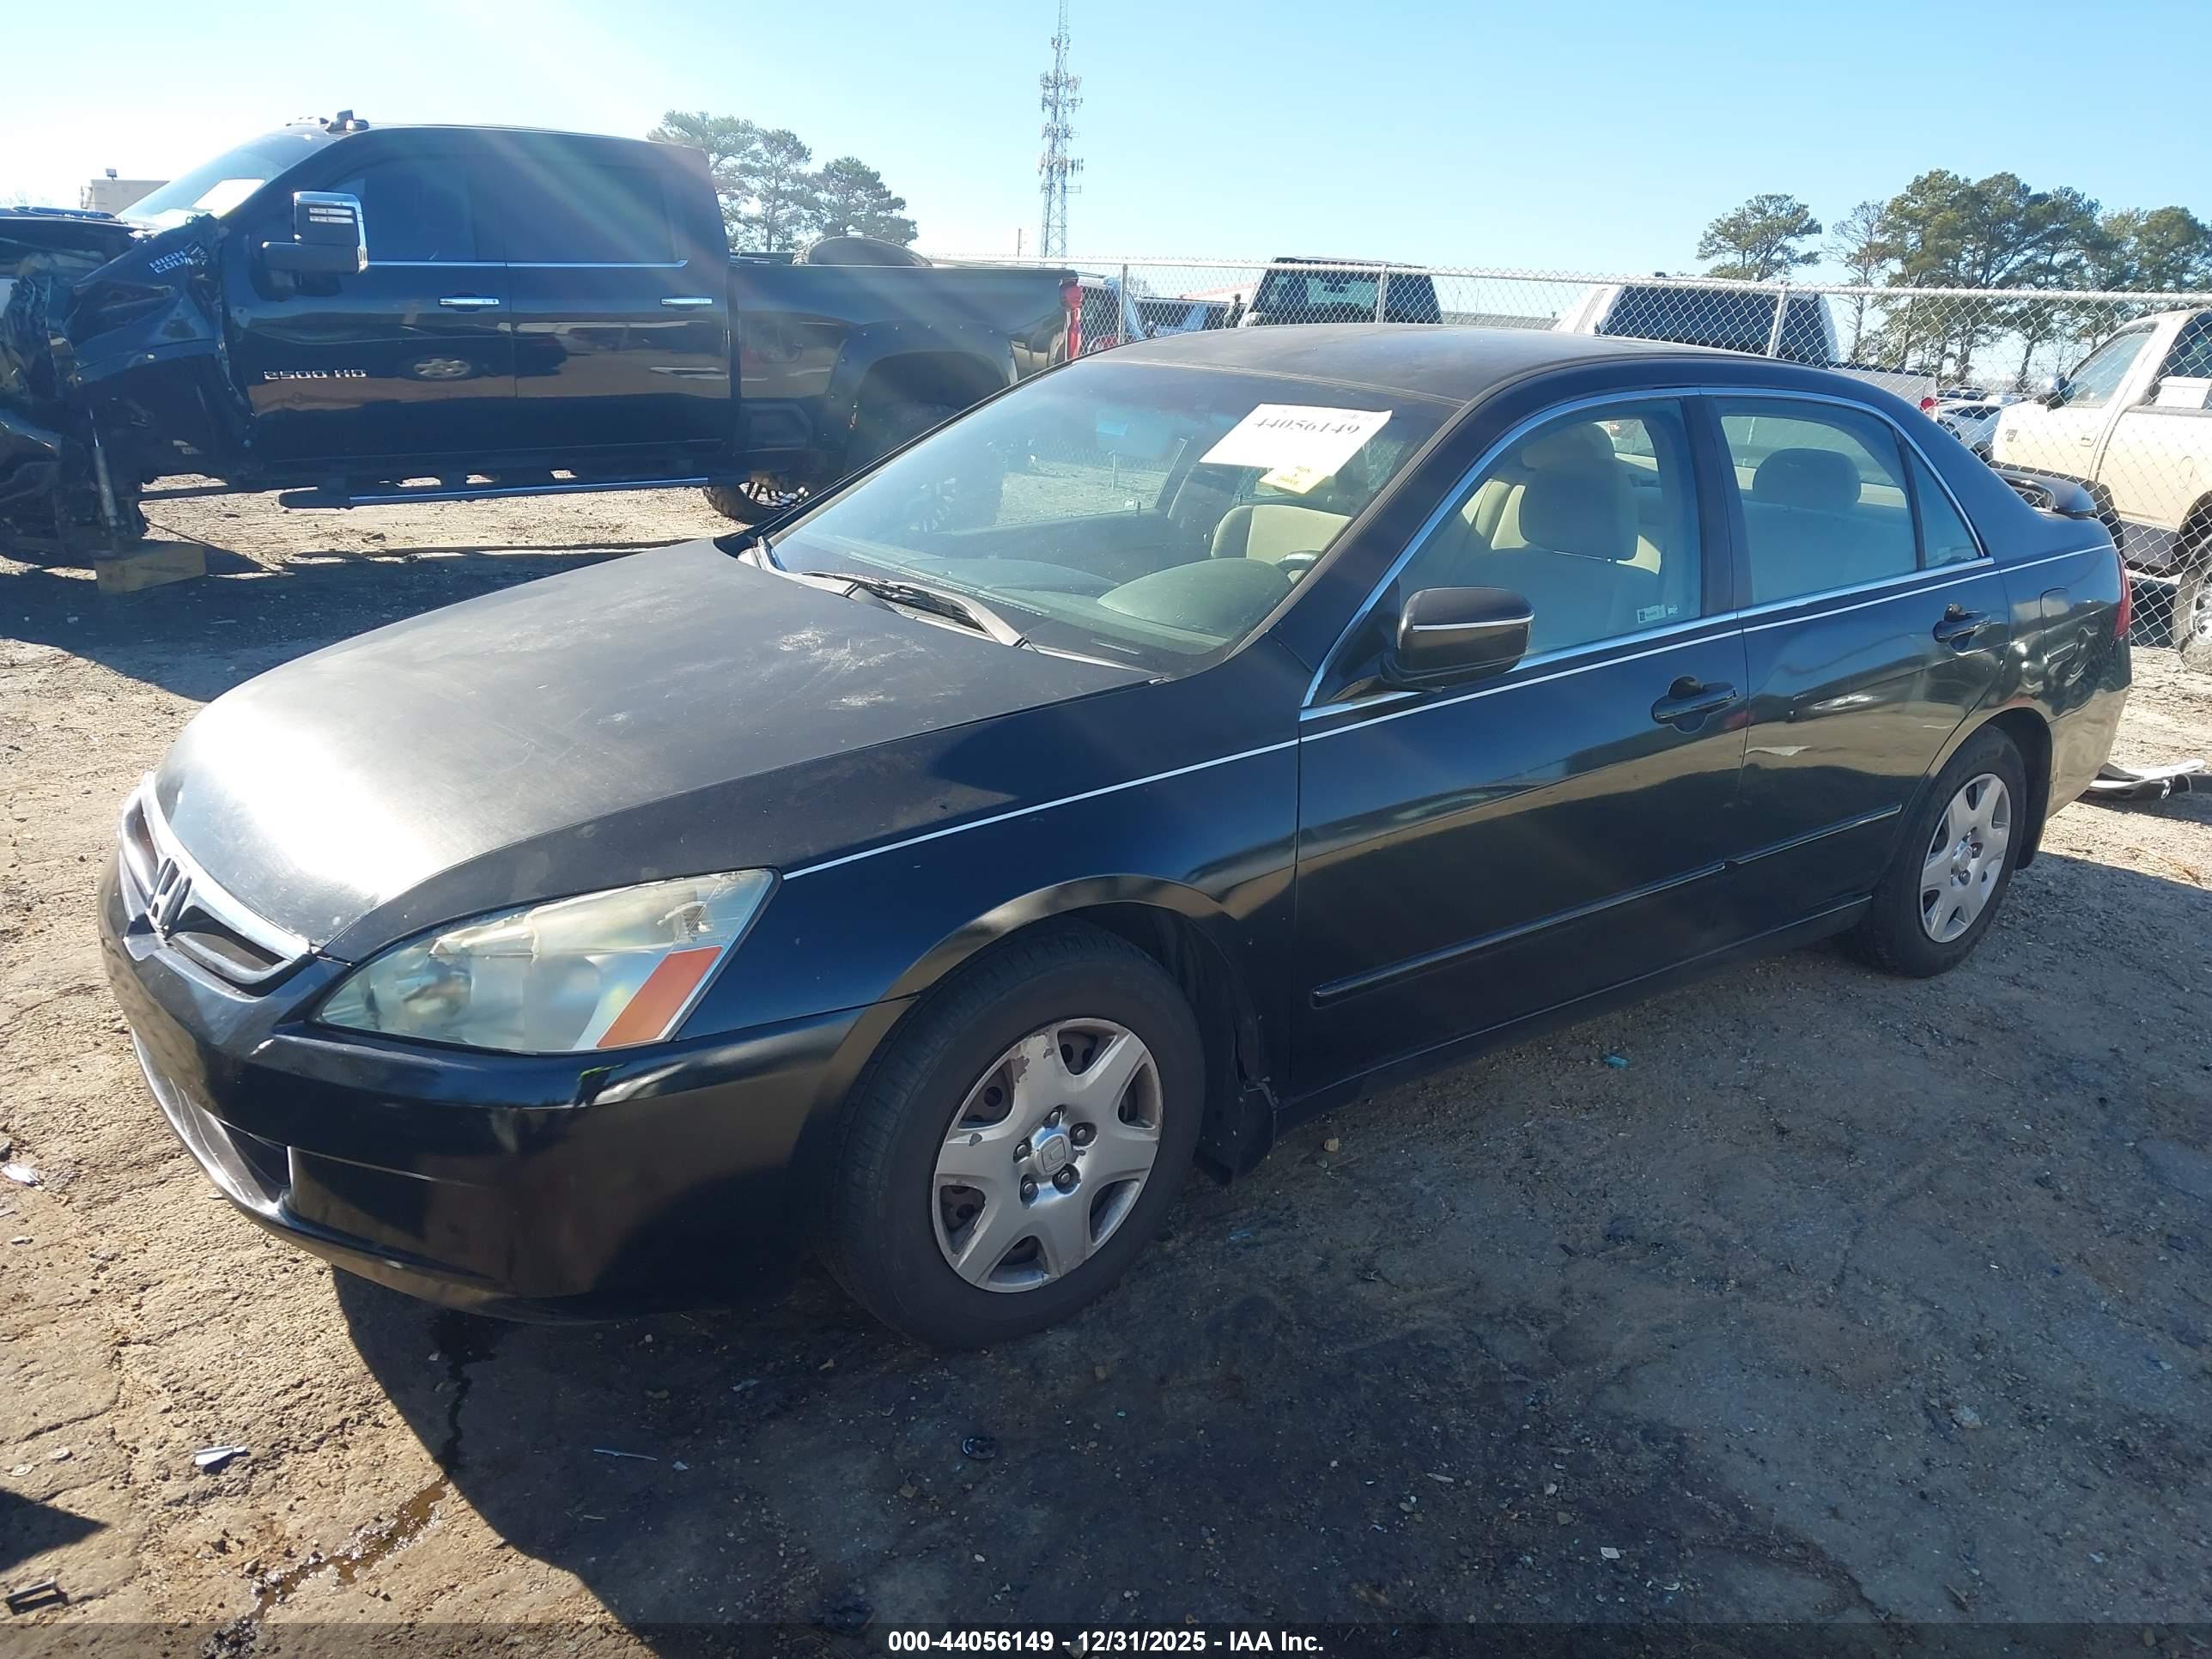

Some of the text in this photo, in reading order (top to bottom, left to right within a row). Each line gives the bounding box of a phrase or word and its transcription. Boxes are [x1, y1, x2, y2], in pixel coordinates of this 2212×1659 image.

[149, 250, 186, 269] HIGH
[263, 368, 367, 380] 2500 HD
[1254, 417, 1361, 434] 44056149
